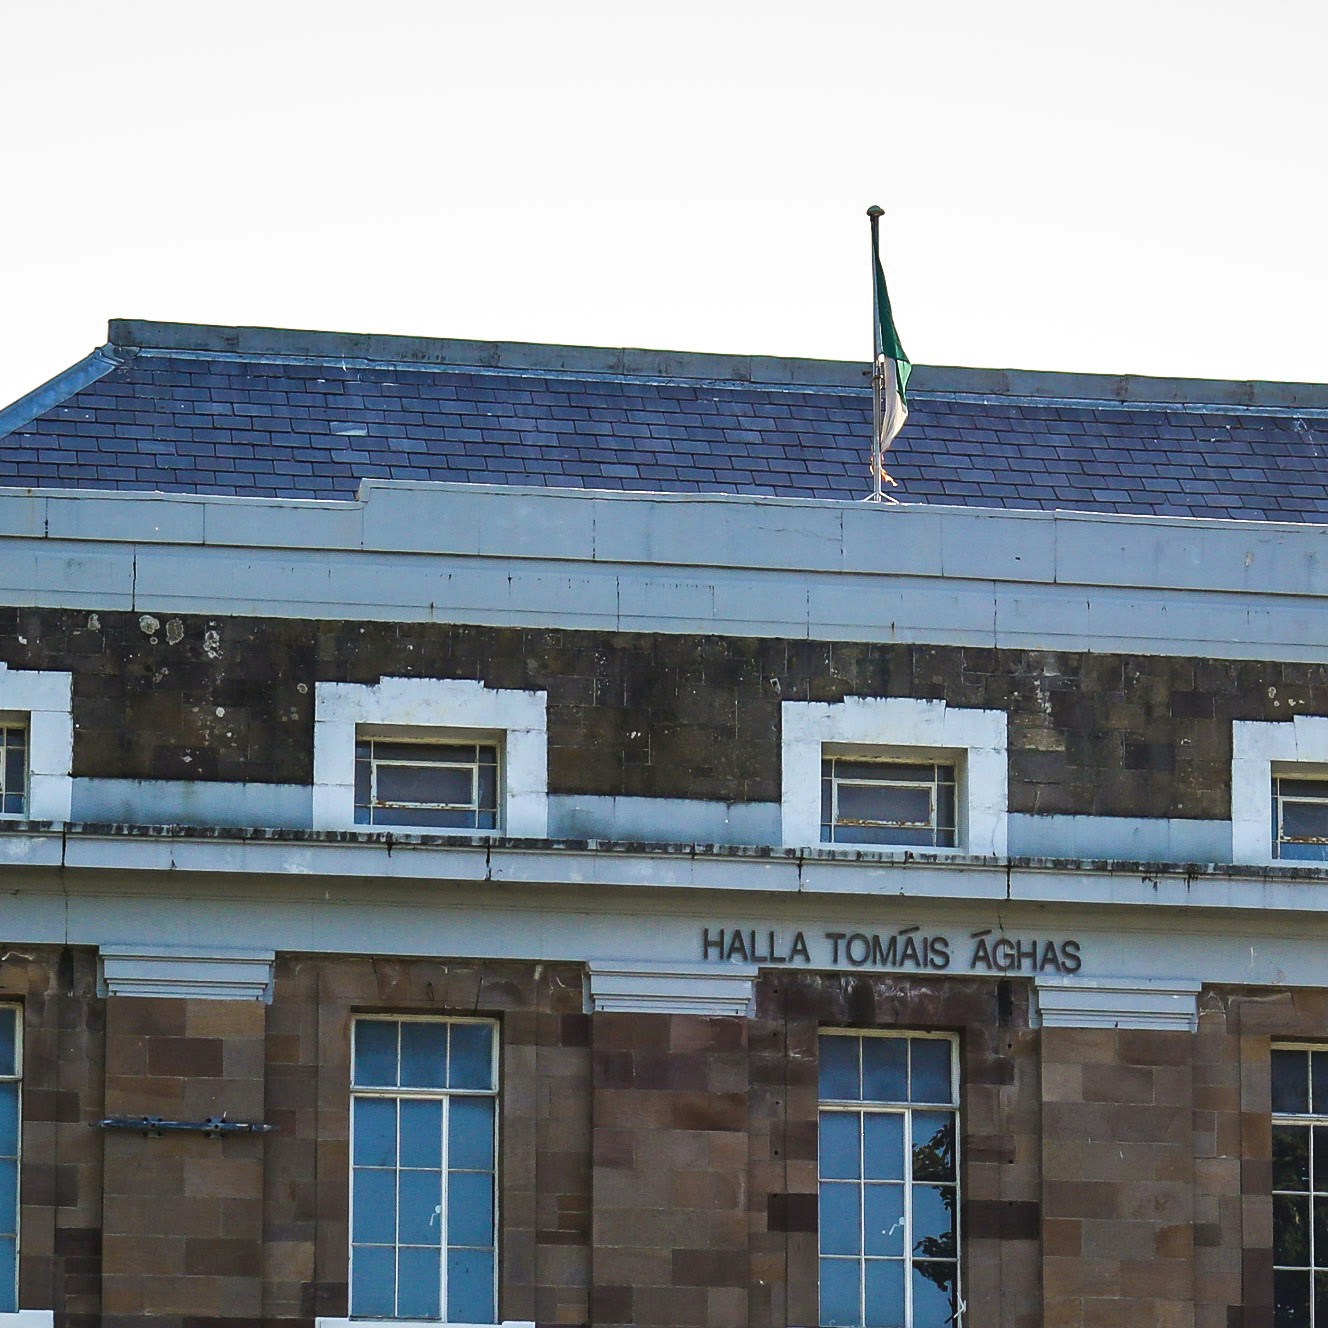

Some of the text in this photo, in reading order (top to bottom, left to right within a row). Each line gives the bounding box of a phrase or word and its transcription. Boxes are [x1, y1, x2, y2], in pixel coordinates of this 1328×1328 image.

[703, 926, 1082, 975] HALLA TOMÁIS ÁGHAS
